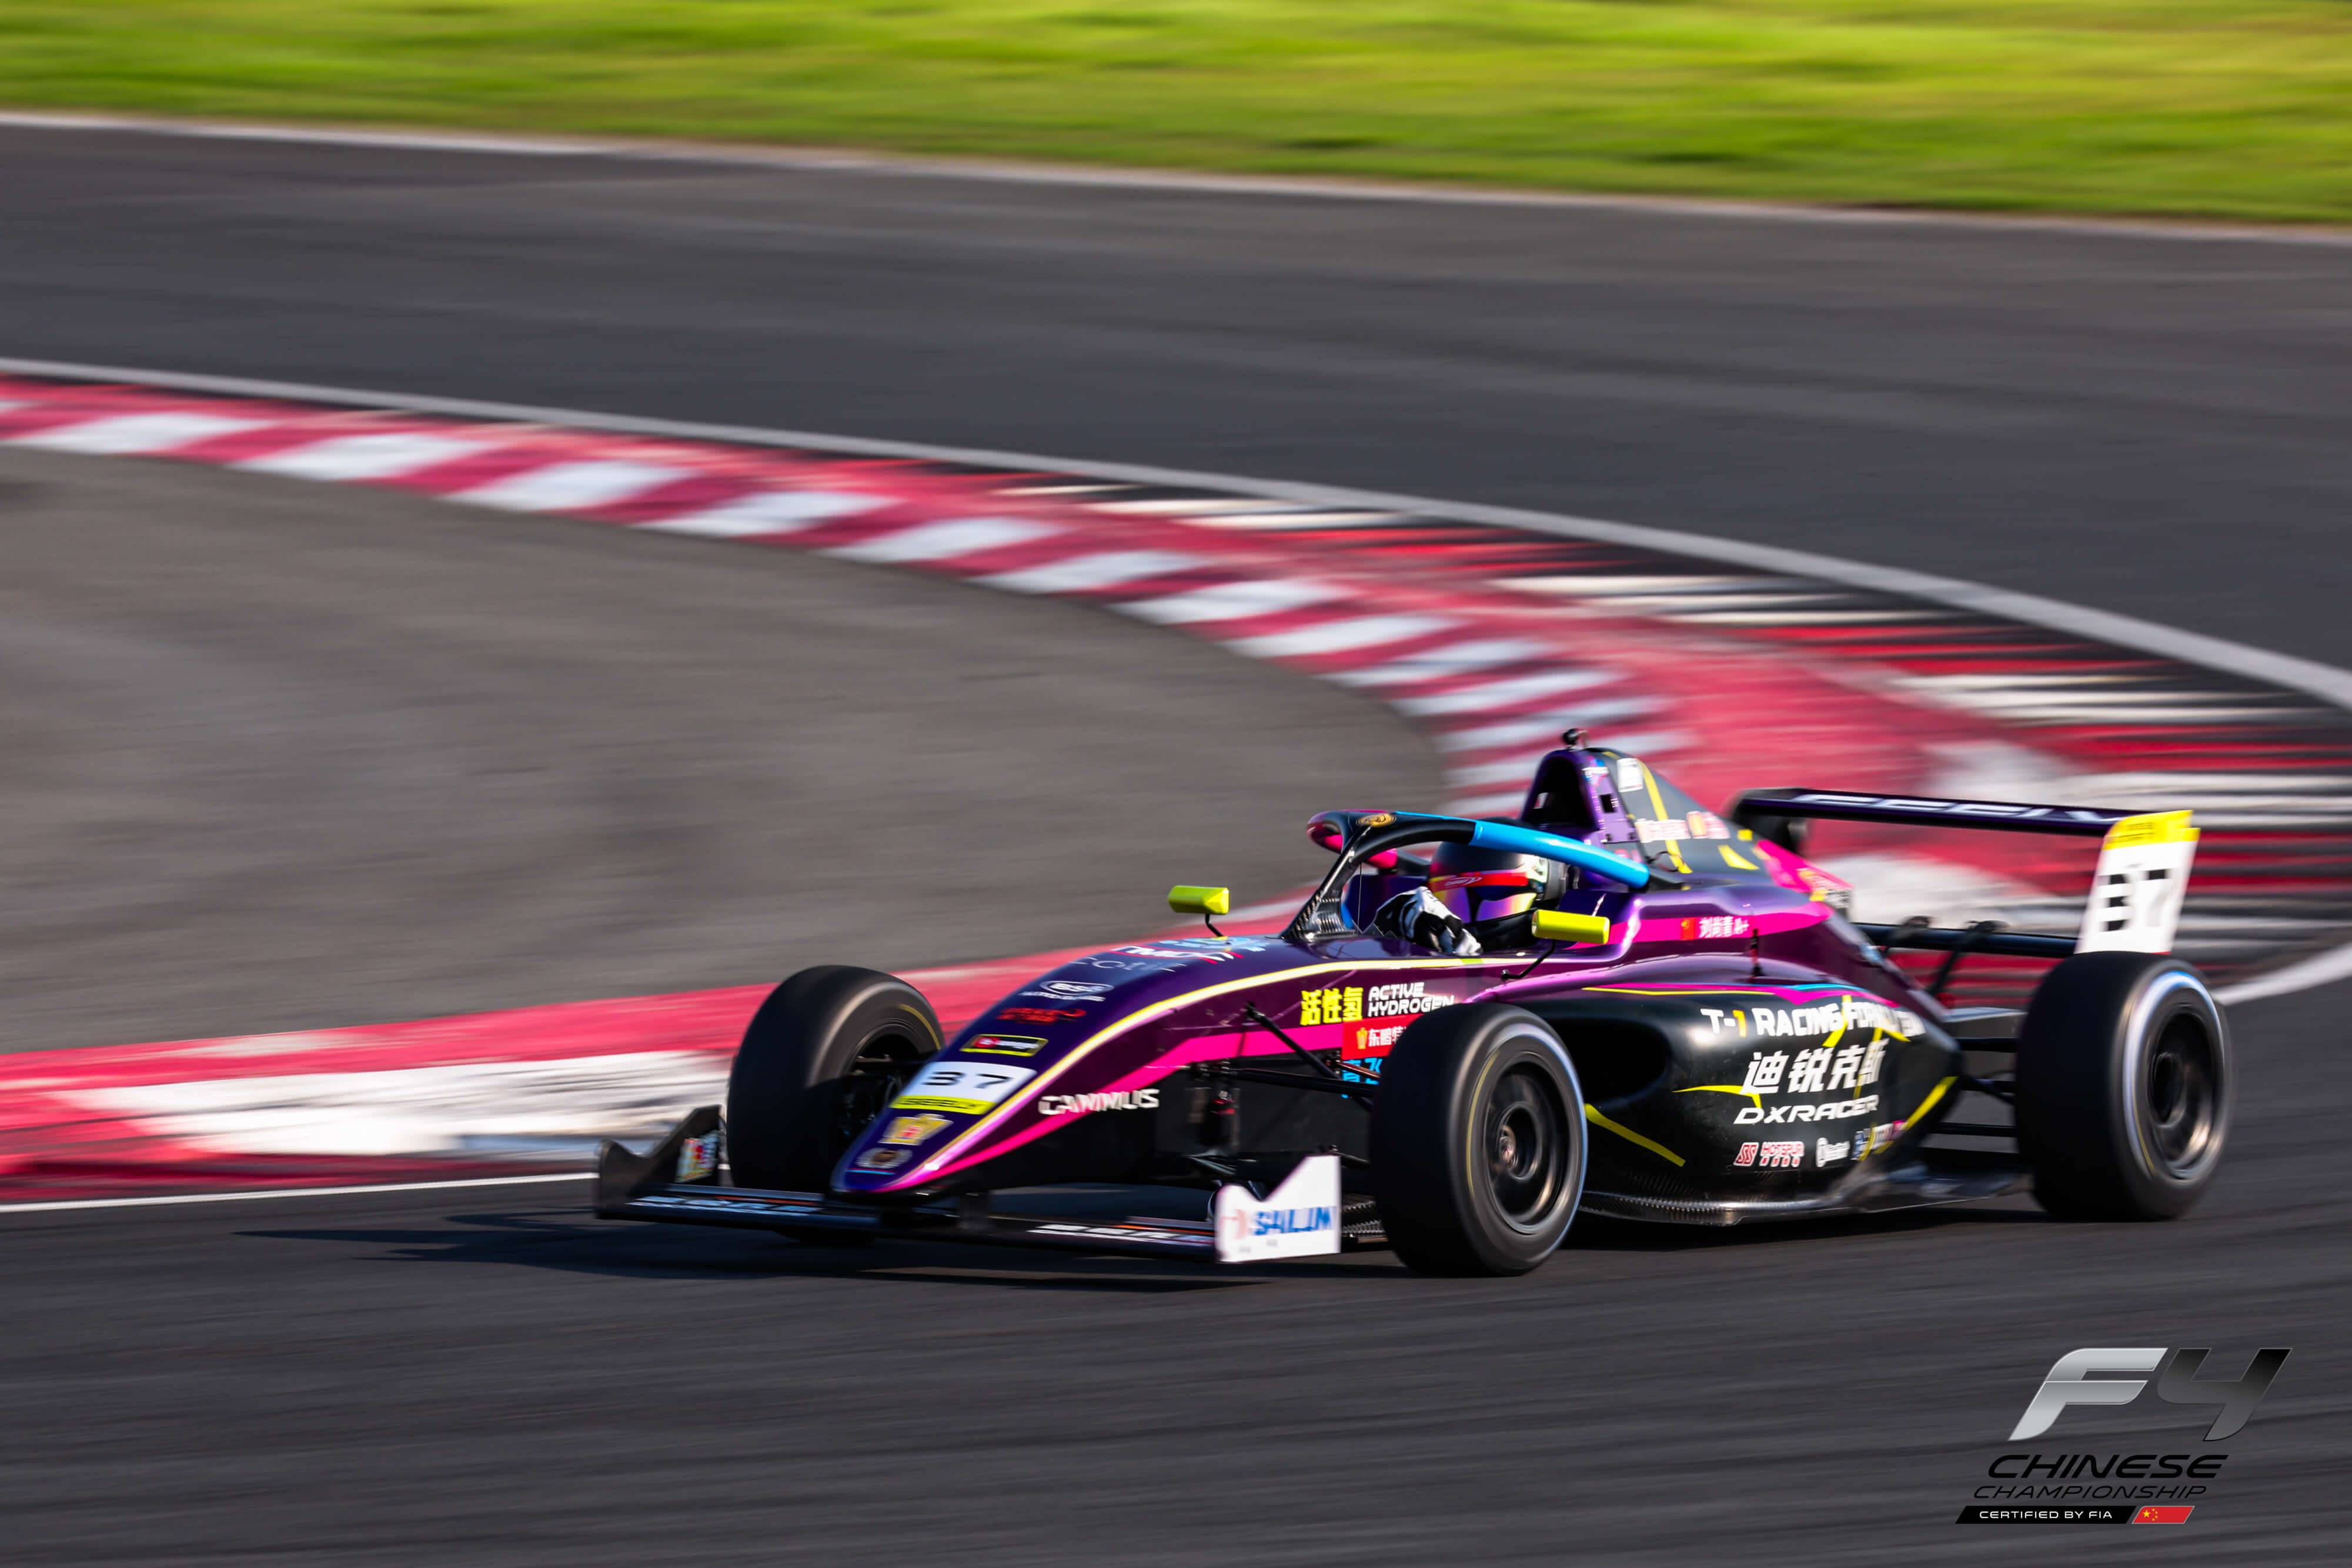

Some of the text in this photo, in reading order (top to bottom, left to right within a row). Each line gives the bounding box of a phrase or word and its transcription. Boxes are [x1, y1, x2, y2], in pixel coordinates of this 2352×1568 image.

[1300, 987, 1364, 1025] 活性氢
[1368, 982, 1425, 1001] ACTIVE
[1368, 995, 1455, 1017] HYDROGEN
[1700, 1008, 1746, 1038] T-1
[1752, 1002, 1842, 1037] RACING
[1368, 1025, 1407, 1047] 东鹏特
[1739, 1038, 1889, 1095] 迪锐克斯
[1733, 1095, 1879, 1124] DXRACER
